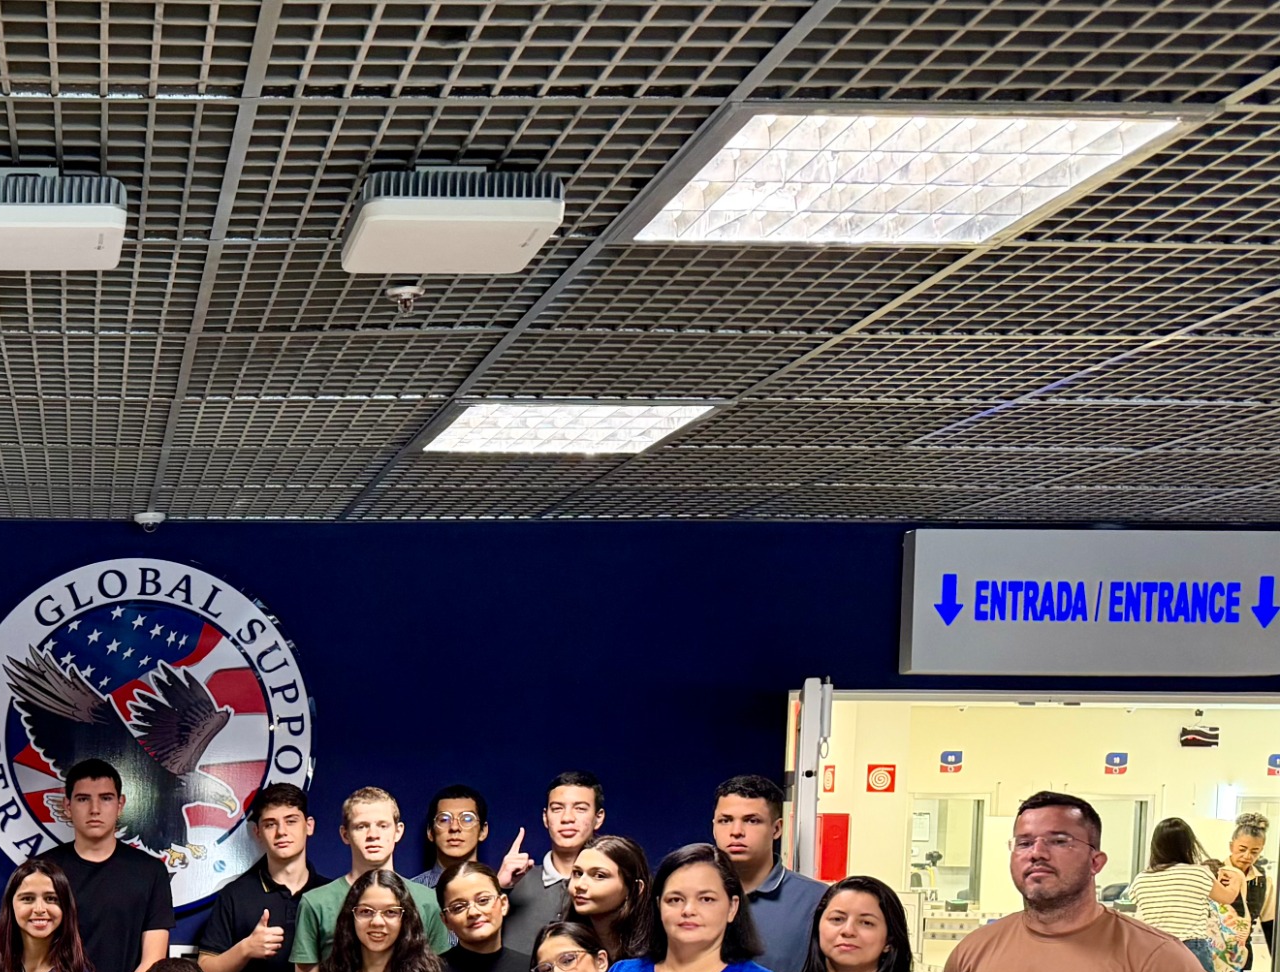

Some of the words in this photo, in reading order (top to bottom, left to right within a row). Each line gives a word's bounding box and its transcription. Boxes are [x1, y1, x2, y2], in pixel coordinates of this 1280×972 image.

[974, 580, 1088, 622] ENTRADA
[1094, 581, 1103, 622] /
[1108, 582, 1241, 623] ENTRANCE
[34, 567, 223, 627] GLOBAL
[236, 618, 305, 775] SUPPO
